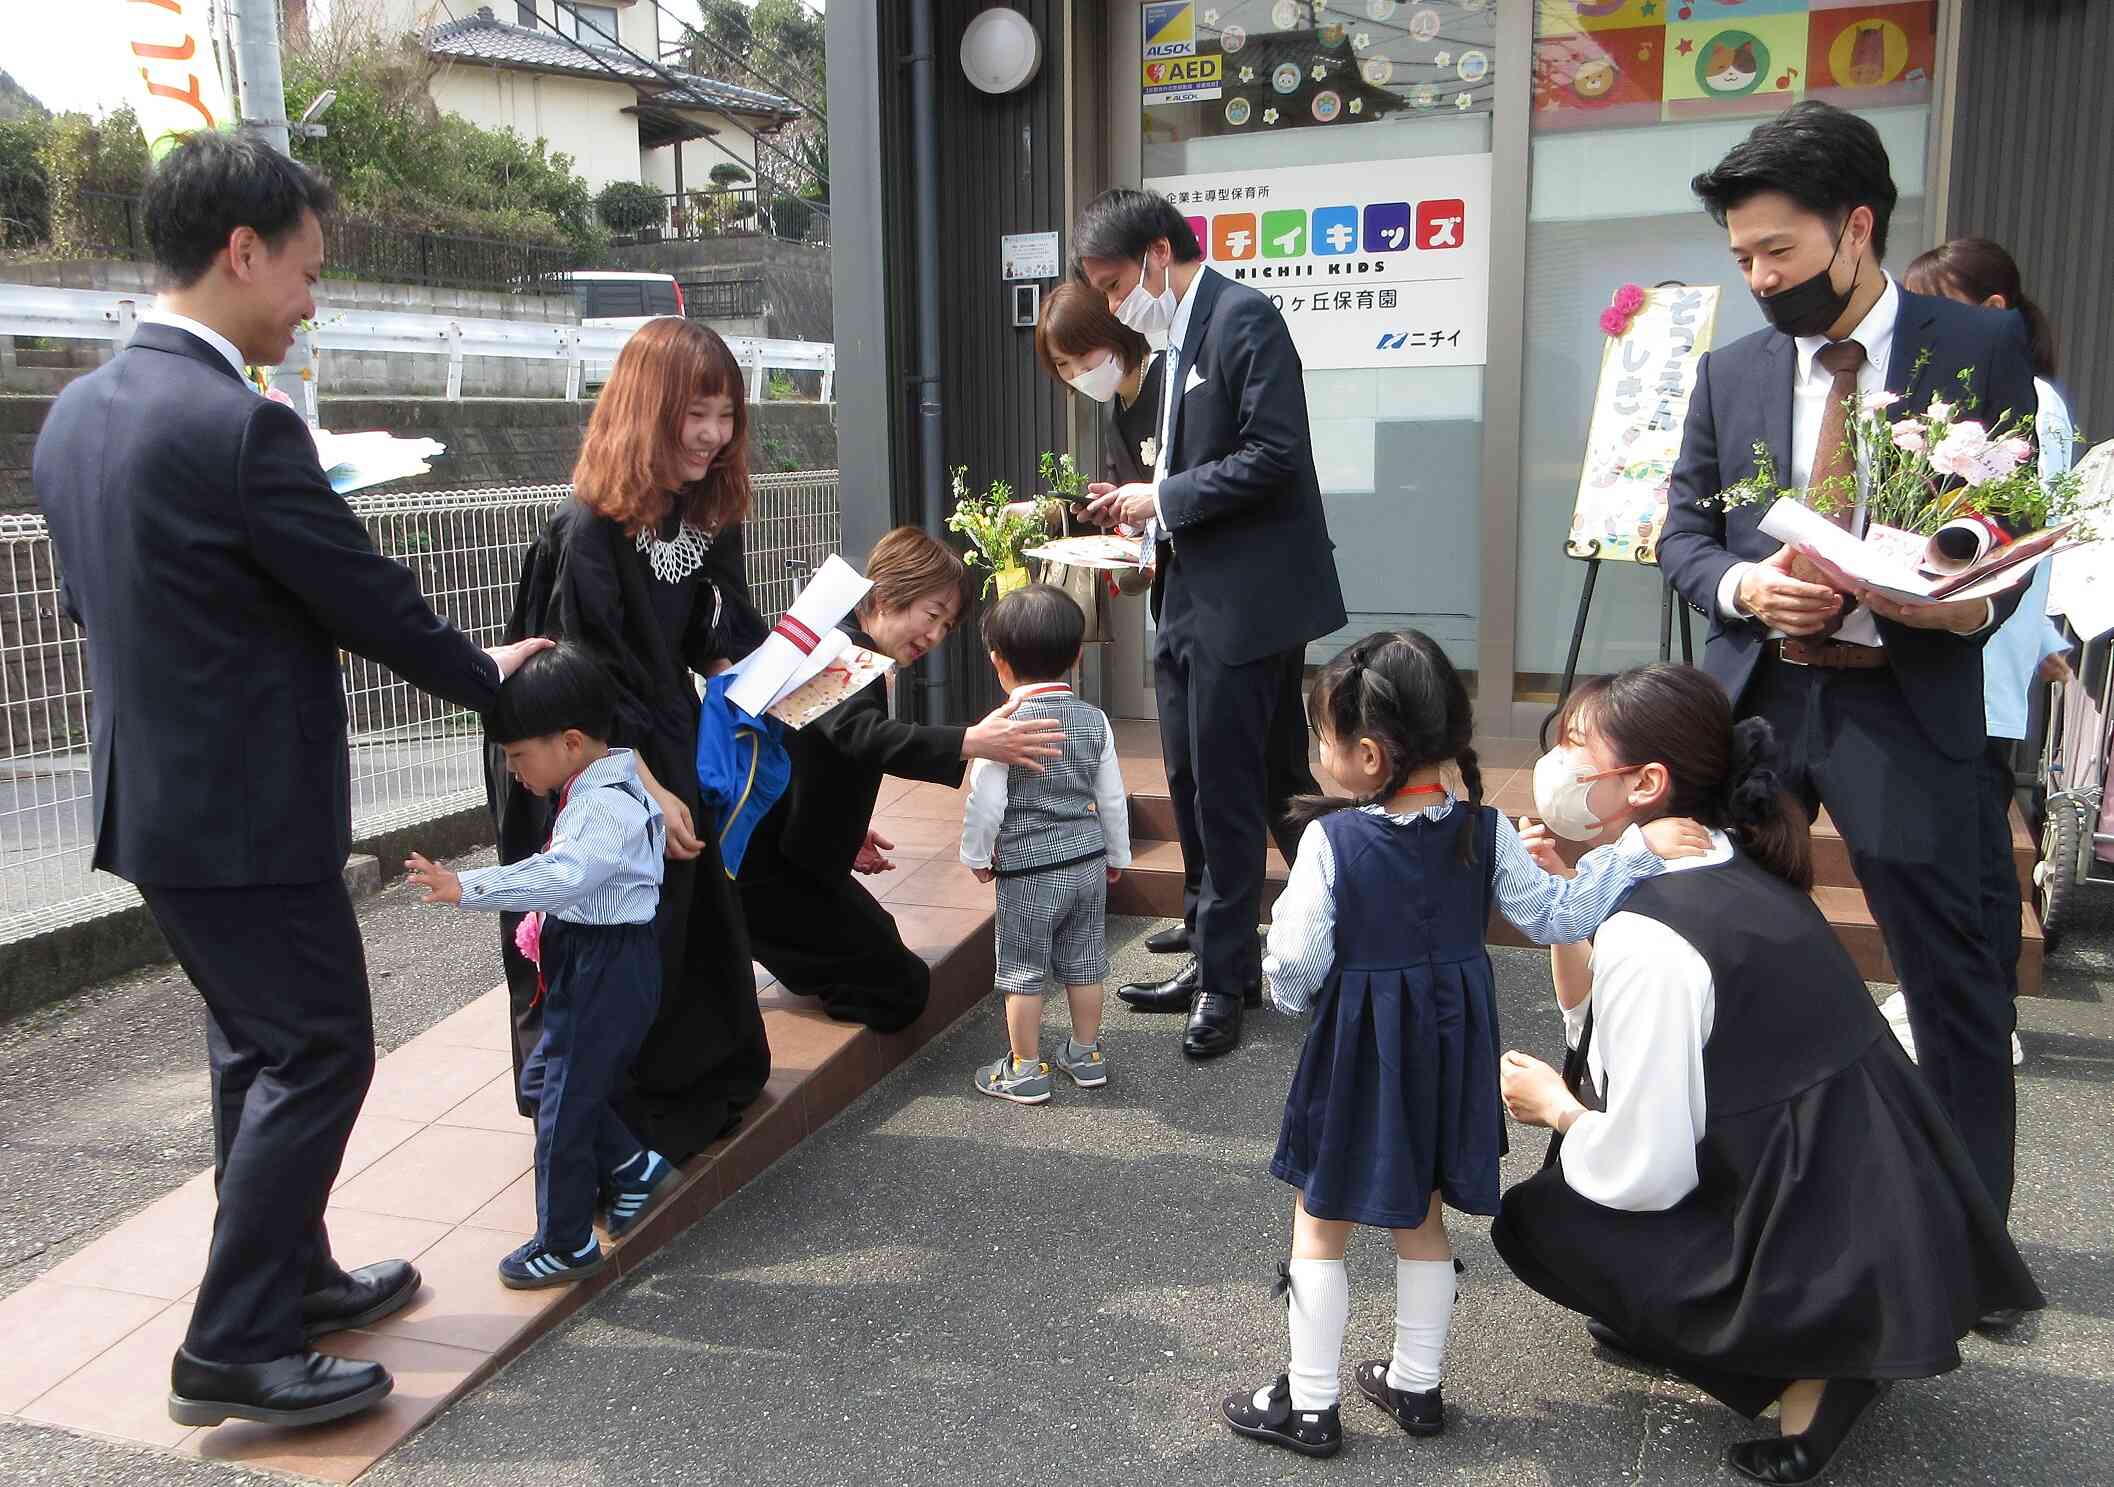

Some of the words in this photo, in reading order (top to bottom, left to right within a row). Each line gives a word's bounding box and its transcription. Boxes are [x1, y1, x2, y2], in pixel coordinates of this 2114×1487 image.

[1146, 43, 1191, 57] ALSOK
[1169, 60, 1216, 80] AED
[1166, 185, 1270, 204] 企業主導型保育所
[1195, 216, 1462, 258] チイキッズ
[1235, 264, 1313, 279] NICHII
[1328, 260, 1386, 276] KIDS
[1410, 329, 1461, 348] ニチイ
